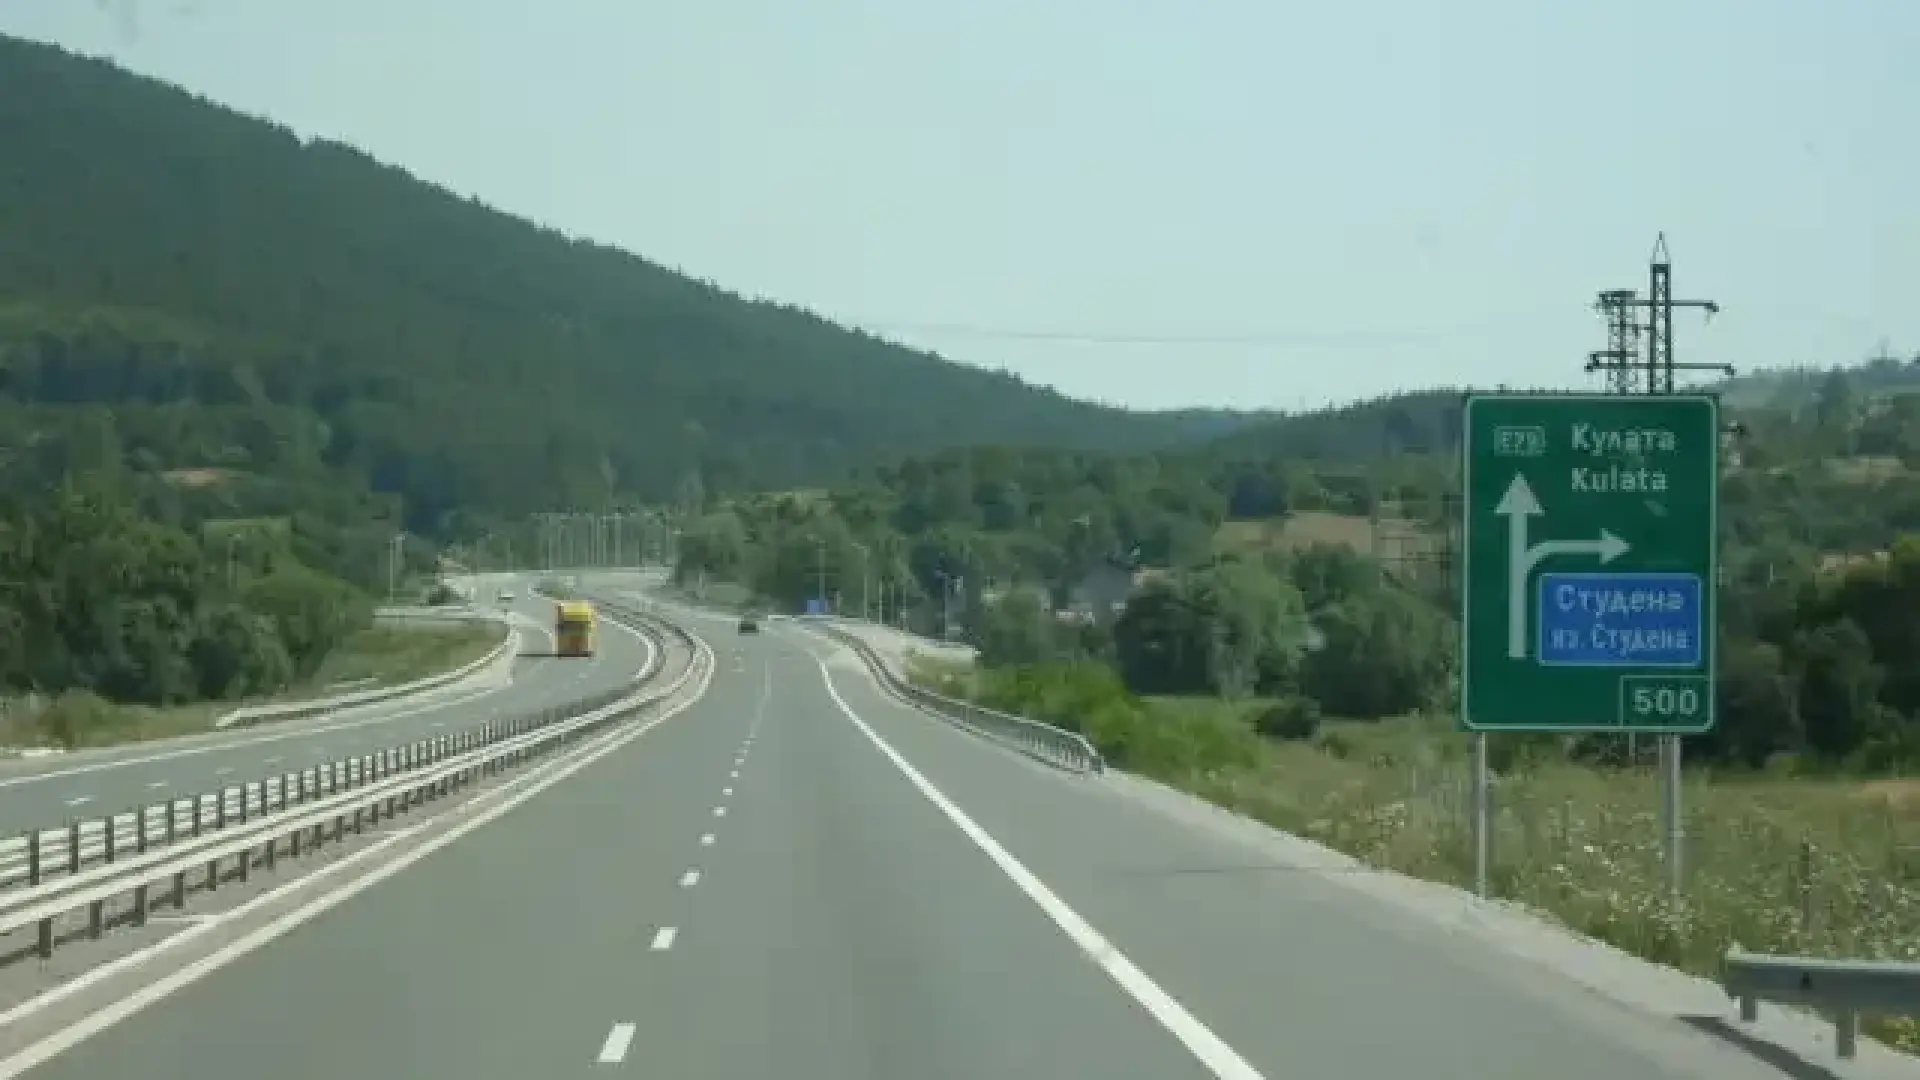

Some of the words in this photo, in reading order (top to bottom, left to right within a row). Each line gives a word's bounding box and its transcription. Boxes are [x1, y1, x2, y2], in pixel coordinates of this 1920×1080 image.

[1571, 423, 1675, 456] Кулата
[1571, 464, 1668, 492] Kulata
[1556, 584, 1684, 618] Студена
[1632, 688, 1699, 715] 500
